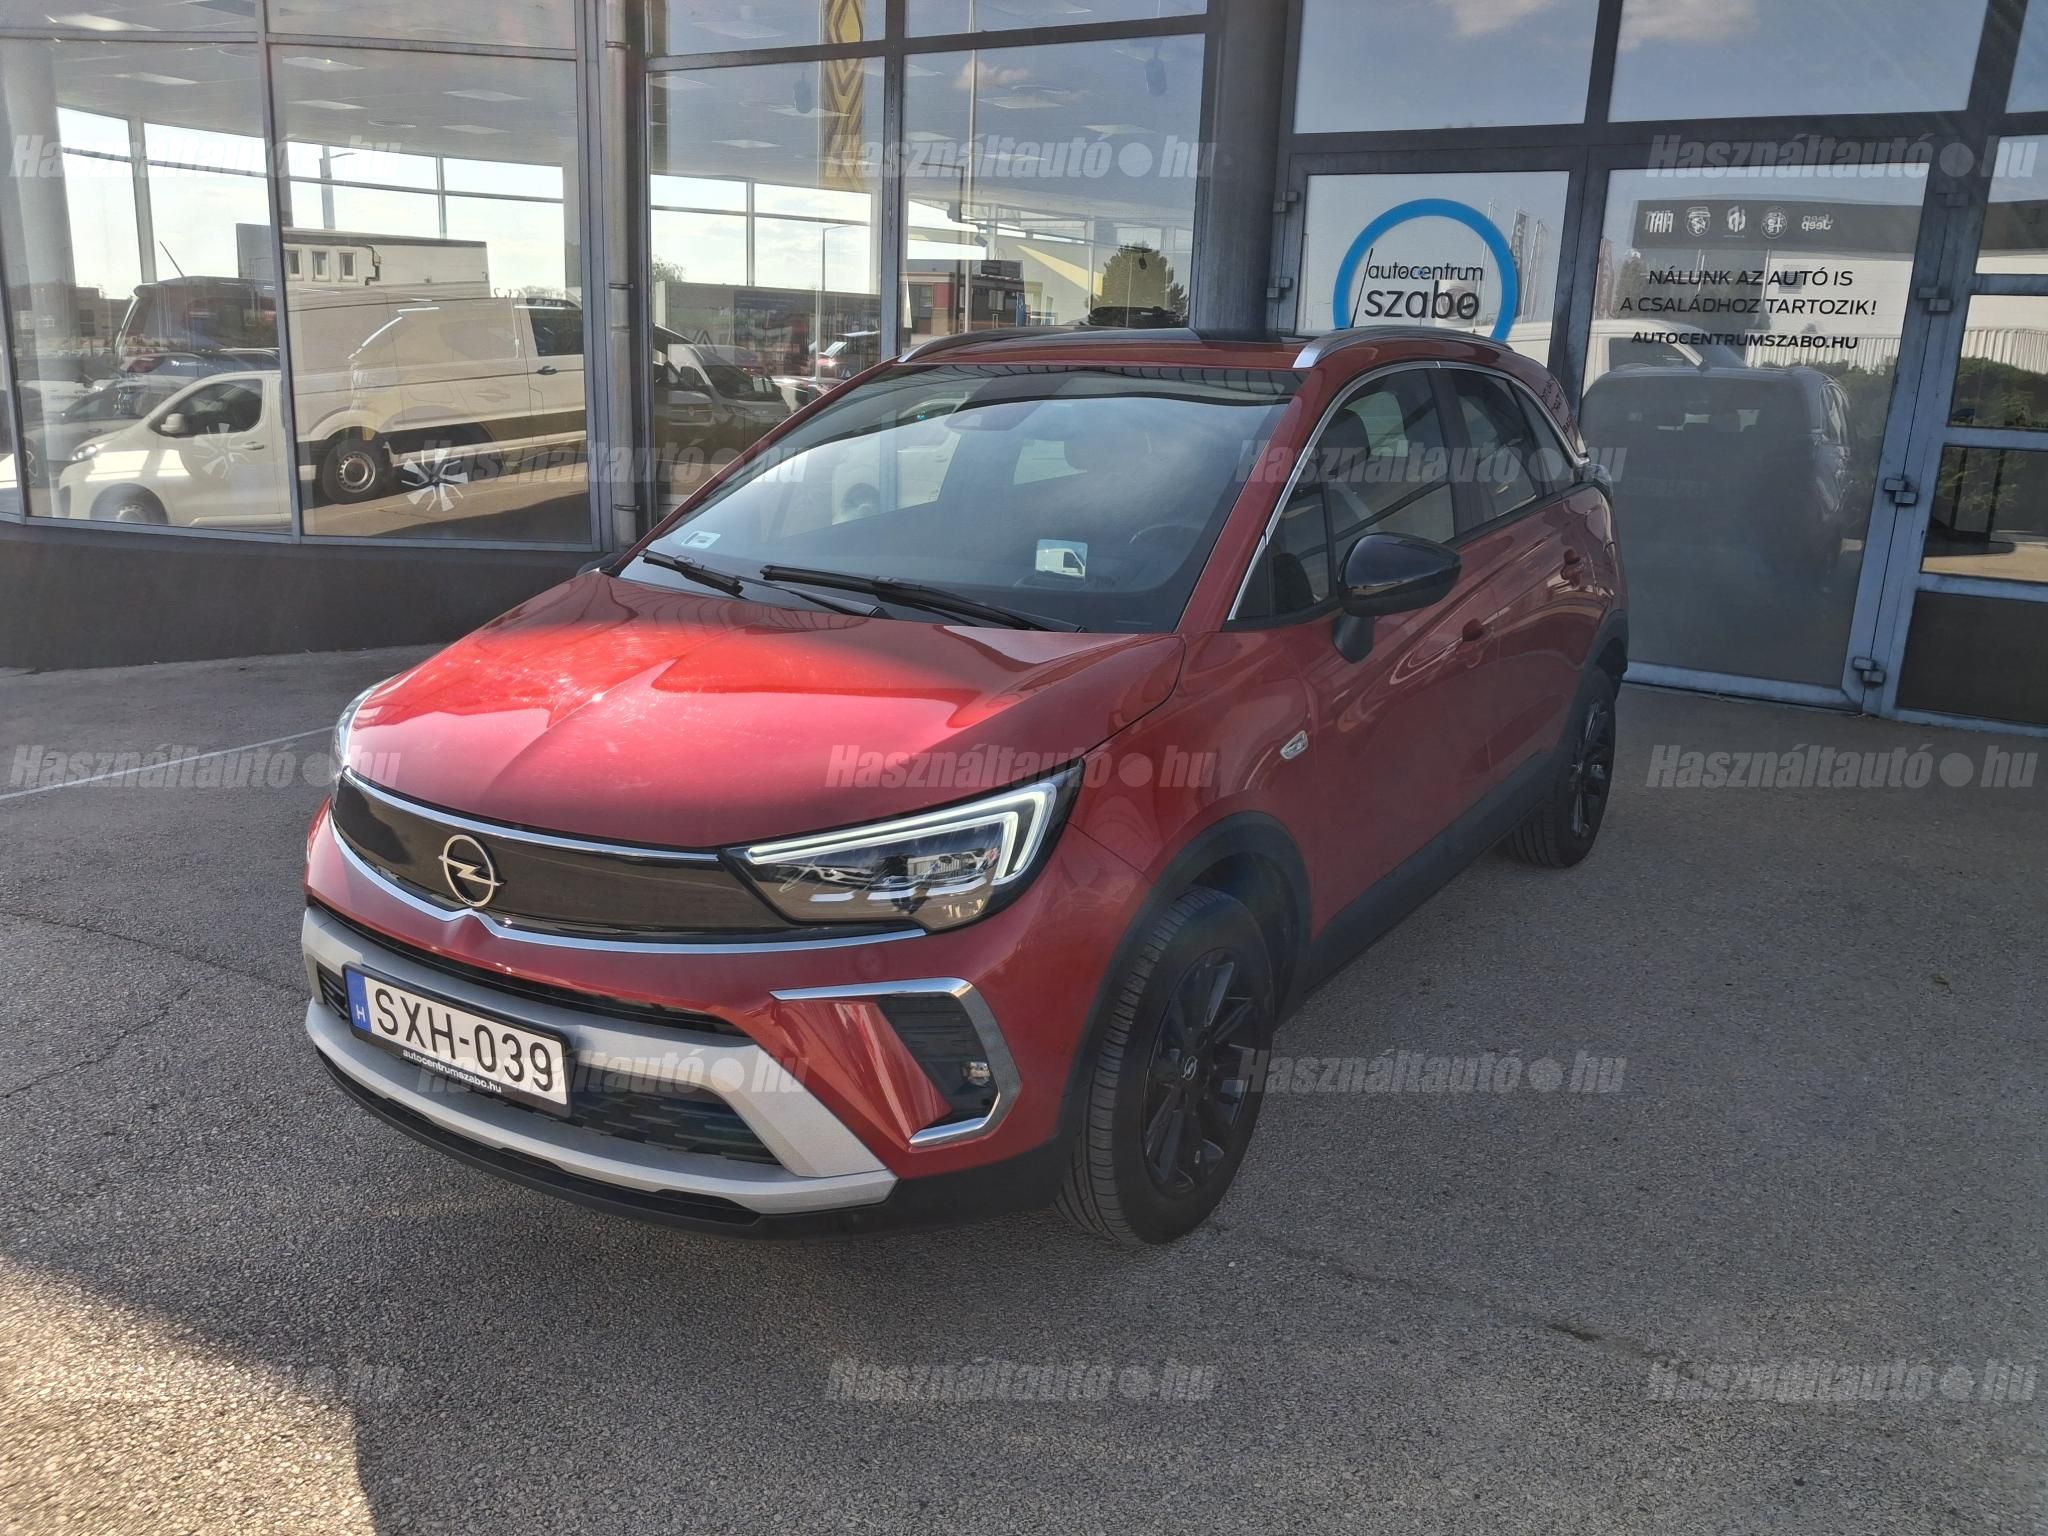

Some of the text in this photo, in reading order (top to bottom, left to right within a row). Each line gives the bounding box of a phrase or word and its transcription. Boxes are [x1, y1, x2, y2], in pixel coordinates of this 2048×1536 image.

[1367, 261, 1484, 281] autocentrum
[1648, 265, 1854, 287] NÁLUNK AZ AUTÓ IS
[1364, 280, 1480, 320] szabo
[1619, 293, 1877, 316] A CSALÁDHOZ TARTOZIK!
[1630, 331, 1859, 350] AUTOCENTRUMSZABO.HU
[356, 1004, 366, 1022] H
[375, 988, 554, 1092] SXH-039
[402, 1049, 503, 1094] autocentrumszabo.hu
